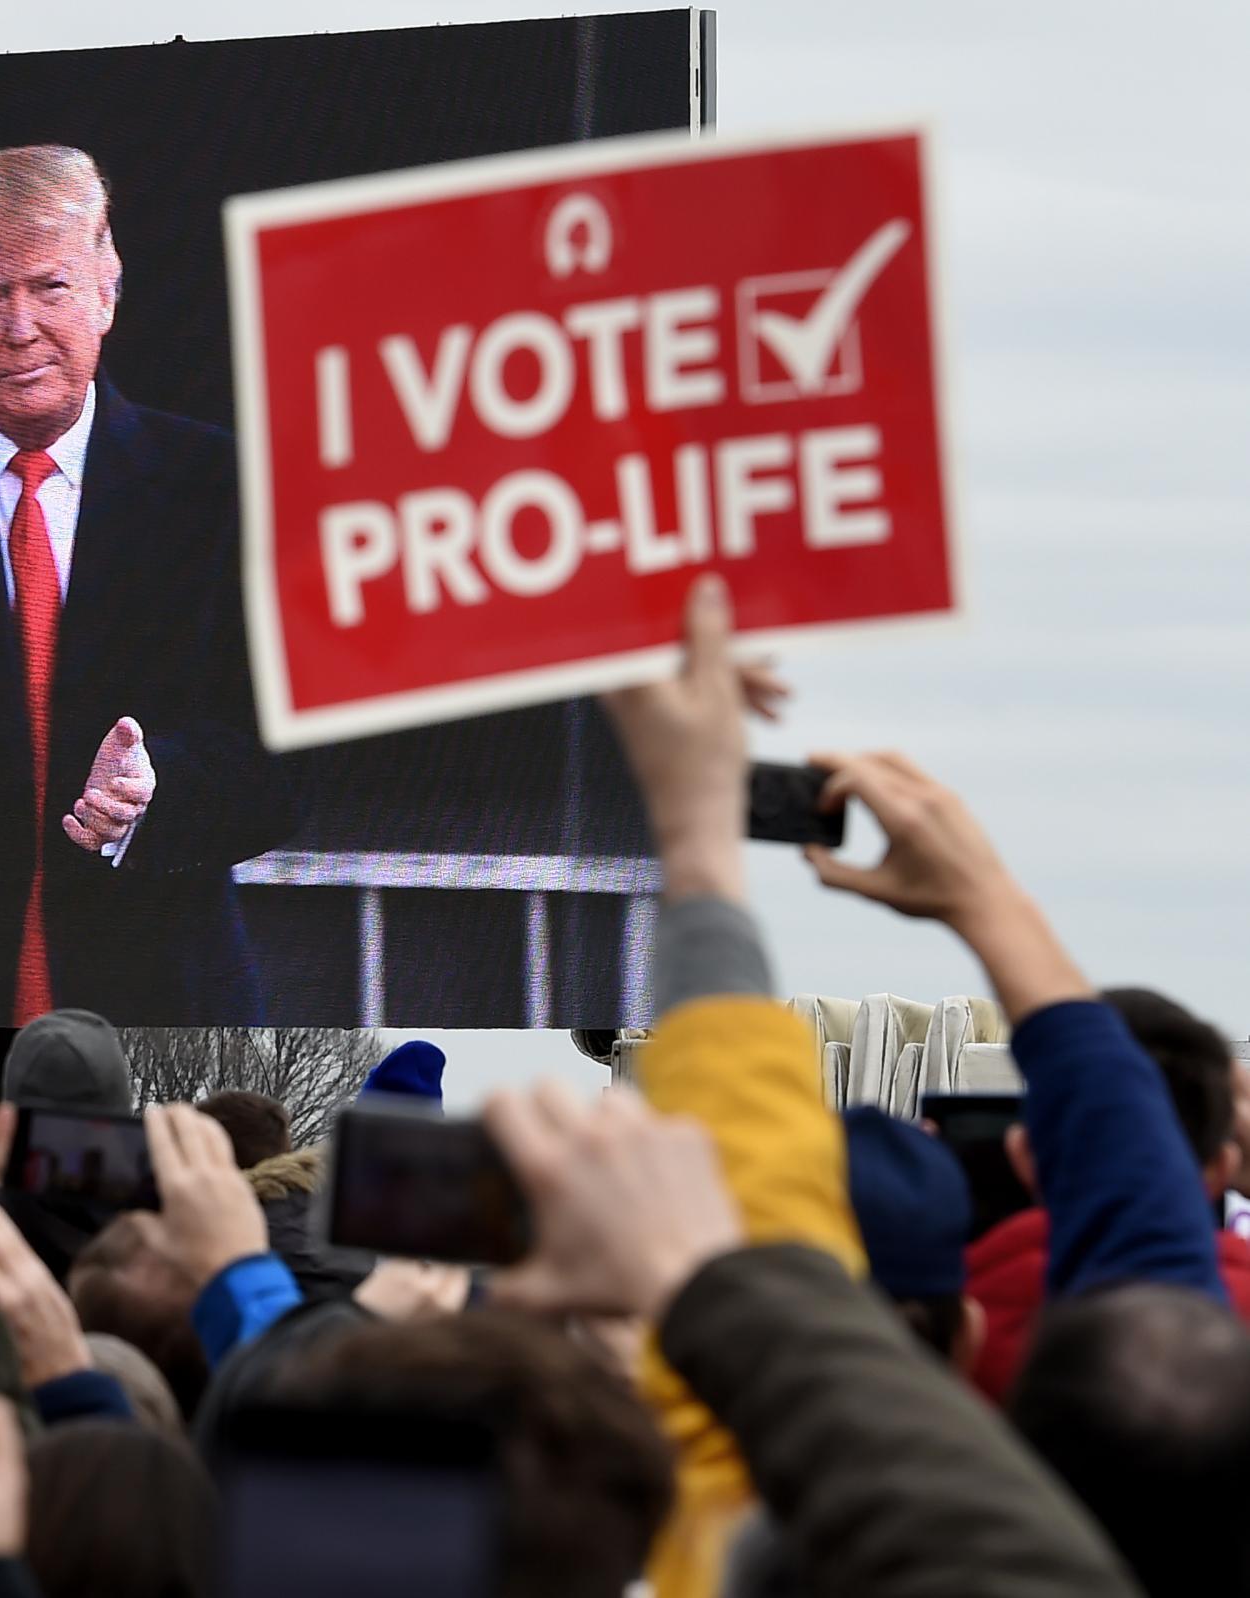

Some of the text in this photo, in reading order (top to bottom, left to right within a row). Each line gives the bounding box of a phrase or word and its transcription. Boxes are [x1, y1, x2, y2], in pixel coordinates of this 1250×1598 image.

[317, 287, 723, 466] I VOTE
[320, 426, 889, 626] PRO-LIFE
